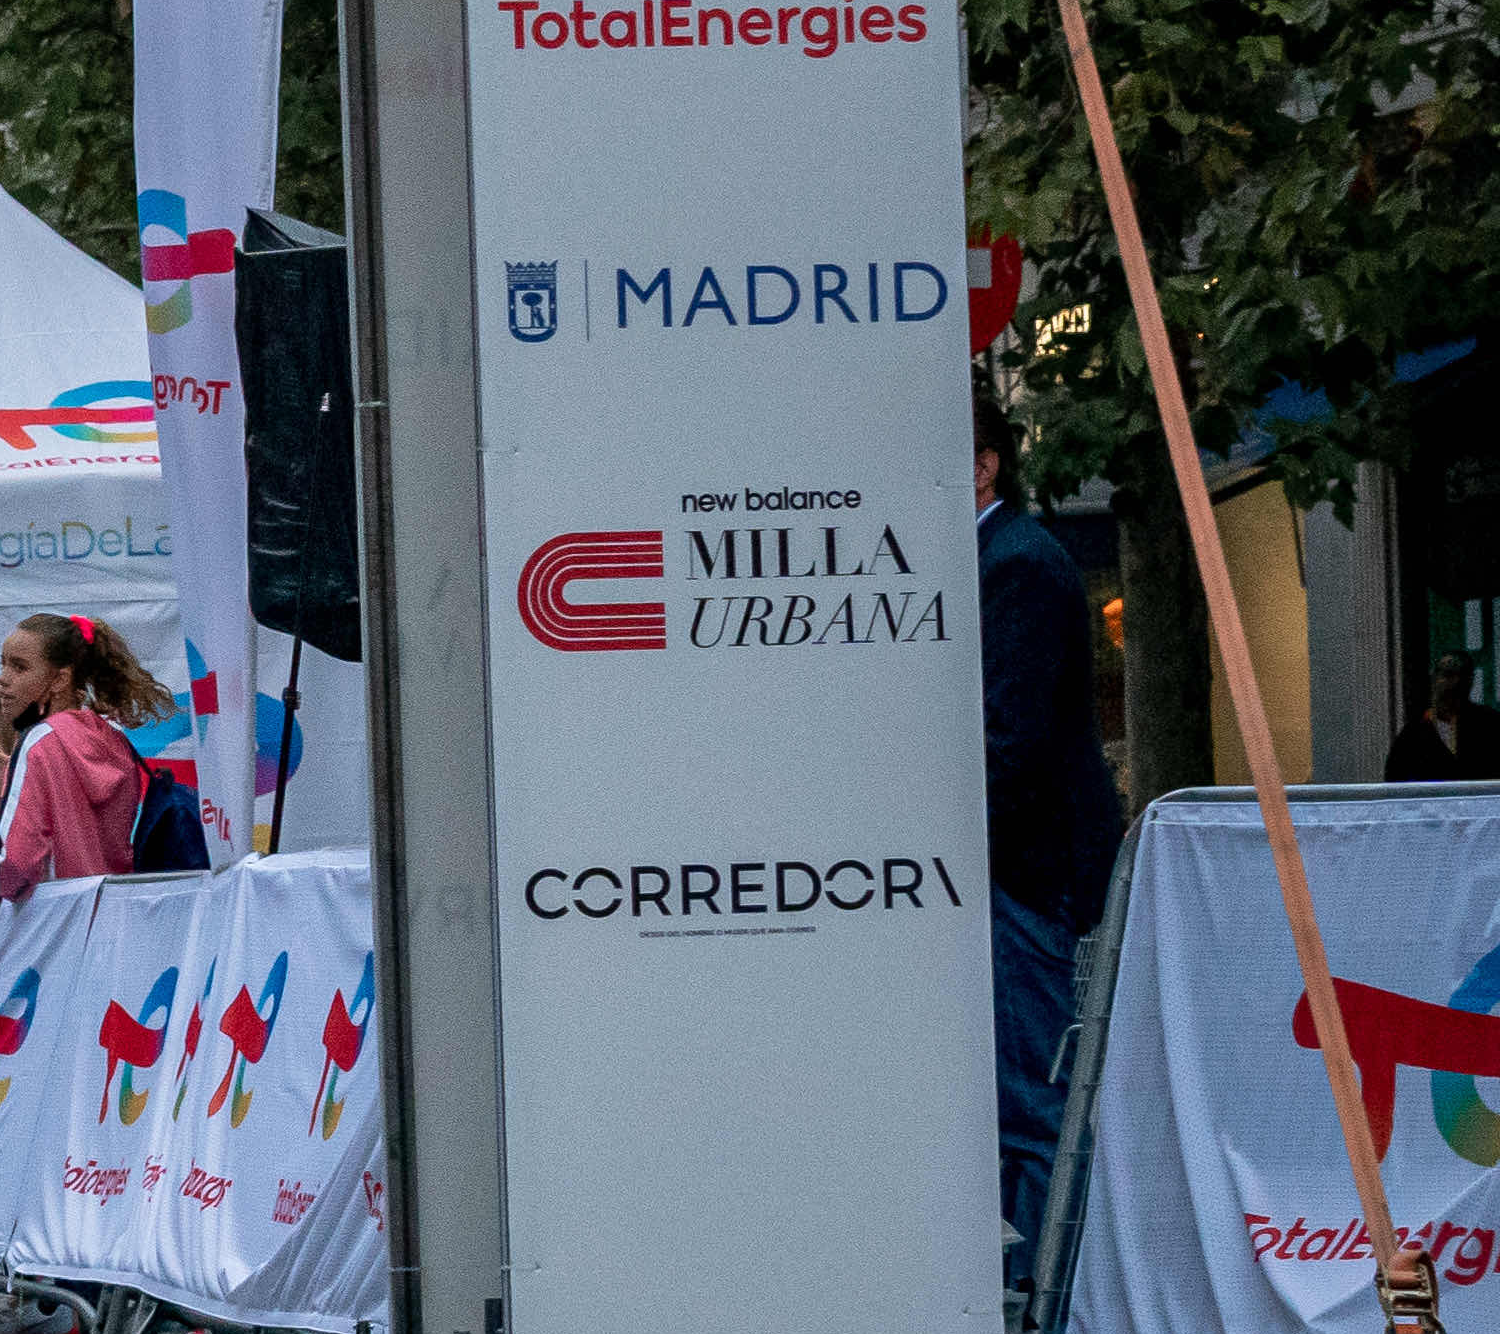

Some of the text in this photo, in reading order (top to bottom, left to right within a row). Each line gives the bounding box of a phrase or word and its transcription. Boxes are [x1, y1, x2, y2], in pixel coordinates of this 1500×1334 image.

[615, 261, 949, 329] MADRID
[681, 485, 862, 513] new balance
[686, 523, 915, 581] MILLA
[688, 590, 952, 649] URBANA
